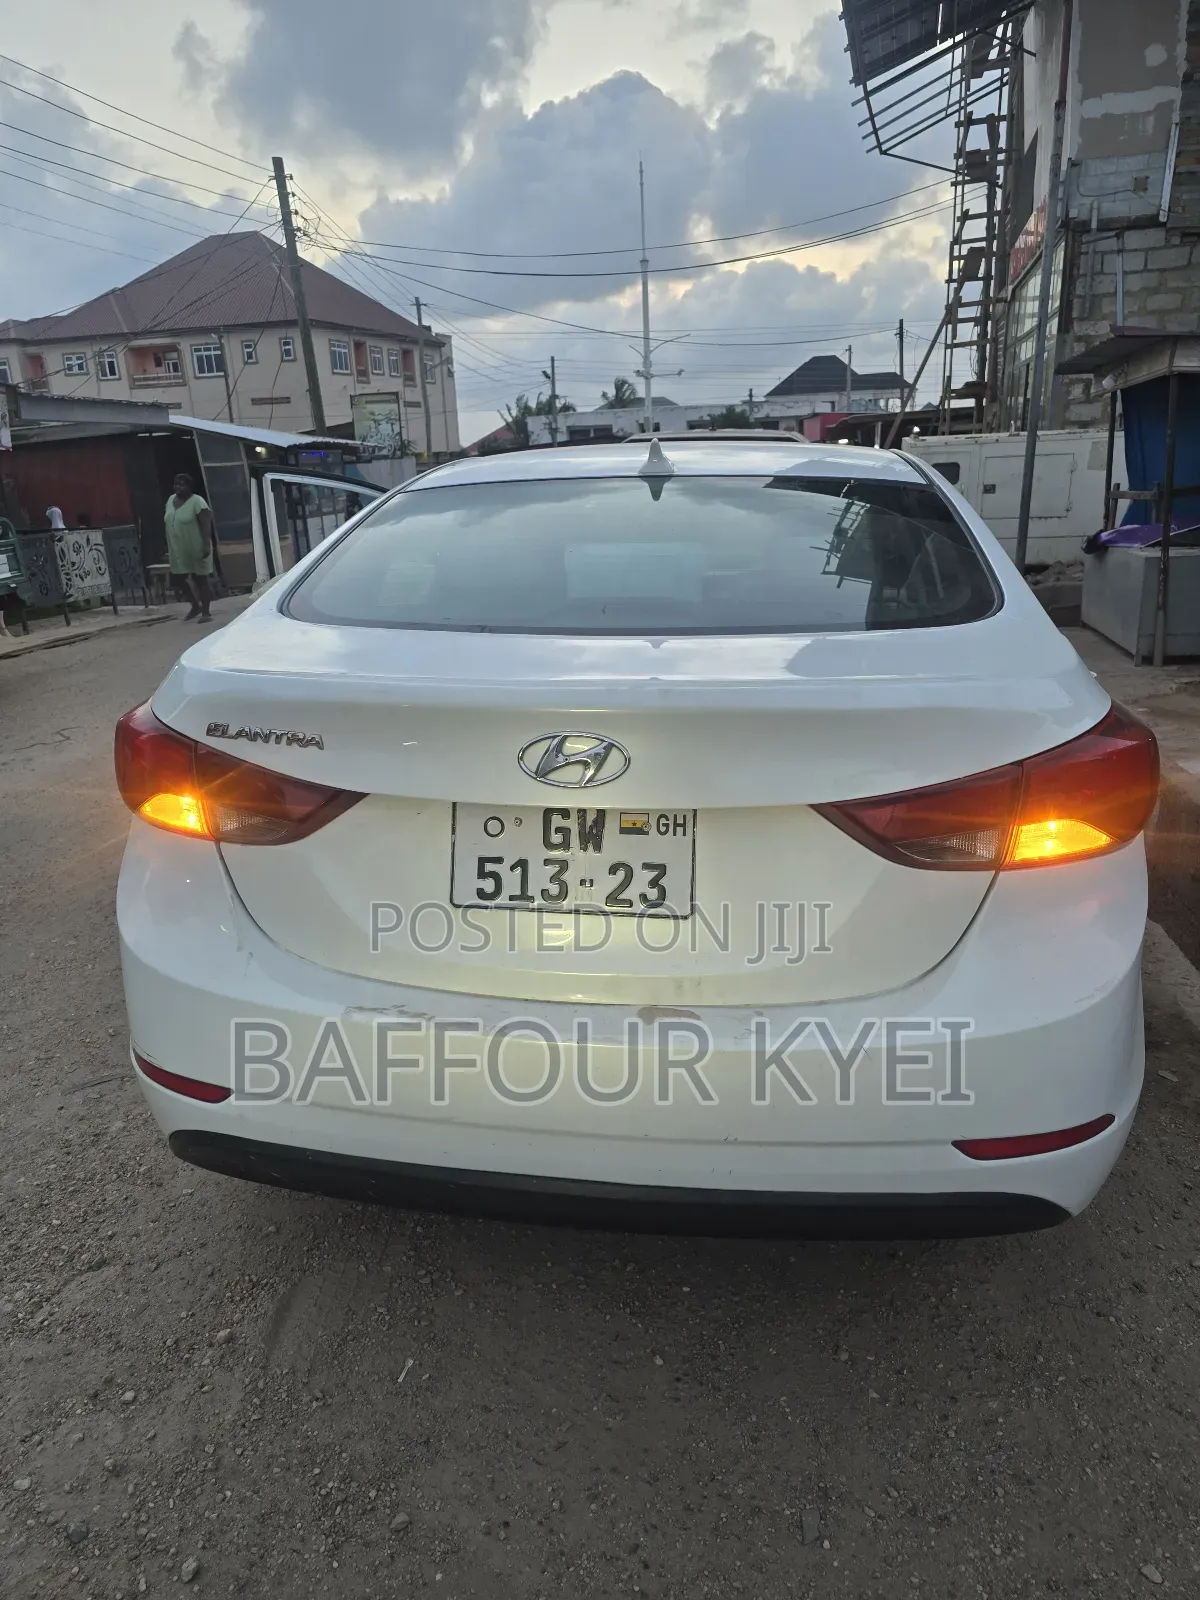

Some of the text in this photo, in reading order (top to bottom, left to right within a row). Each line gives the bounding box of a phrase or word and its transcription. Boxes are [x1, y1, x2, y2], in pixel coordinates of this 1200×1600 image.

[206, 722, 324, 750] ELANTRA
[542, 807, 688, 853] GW GH
